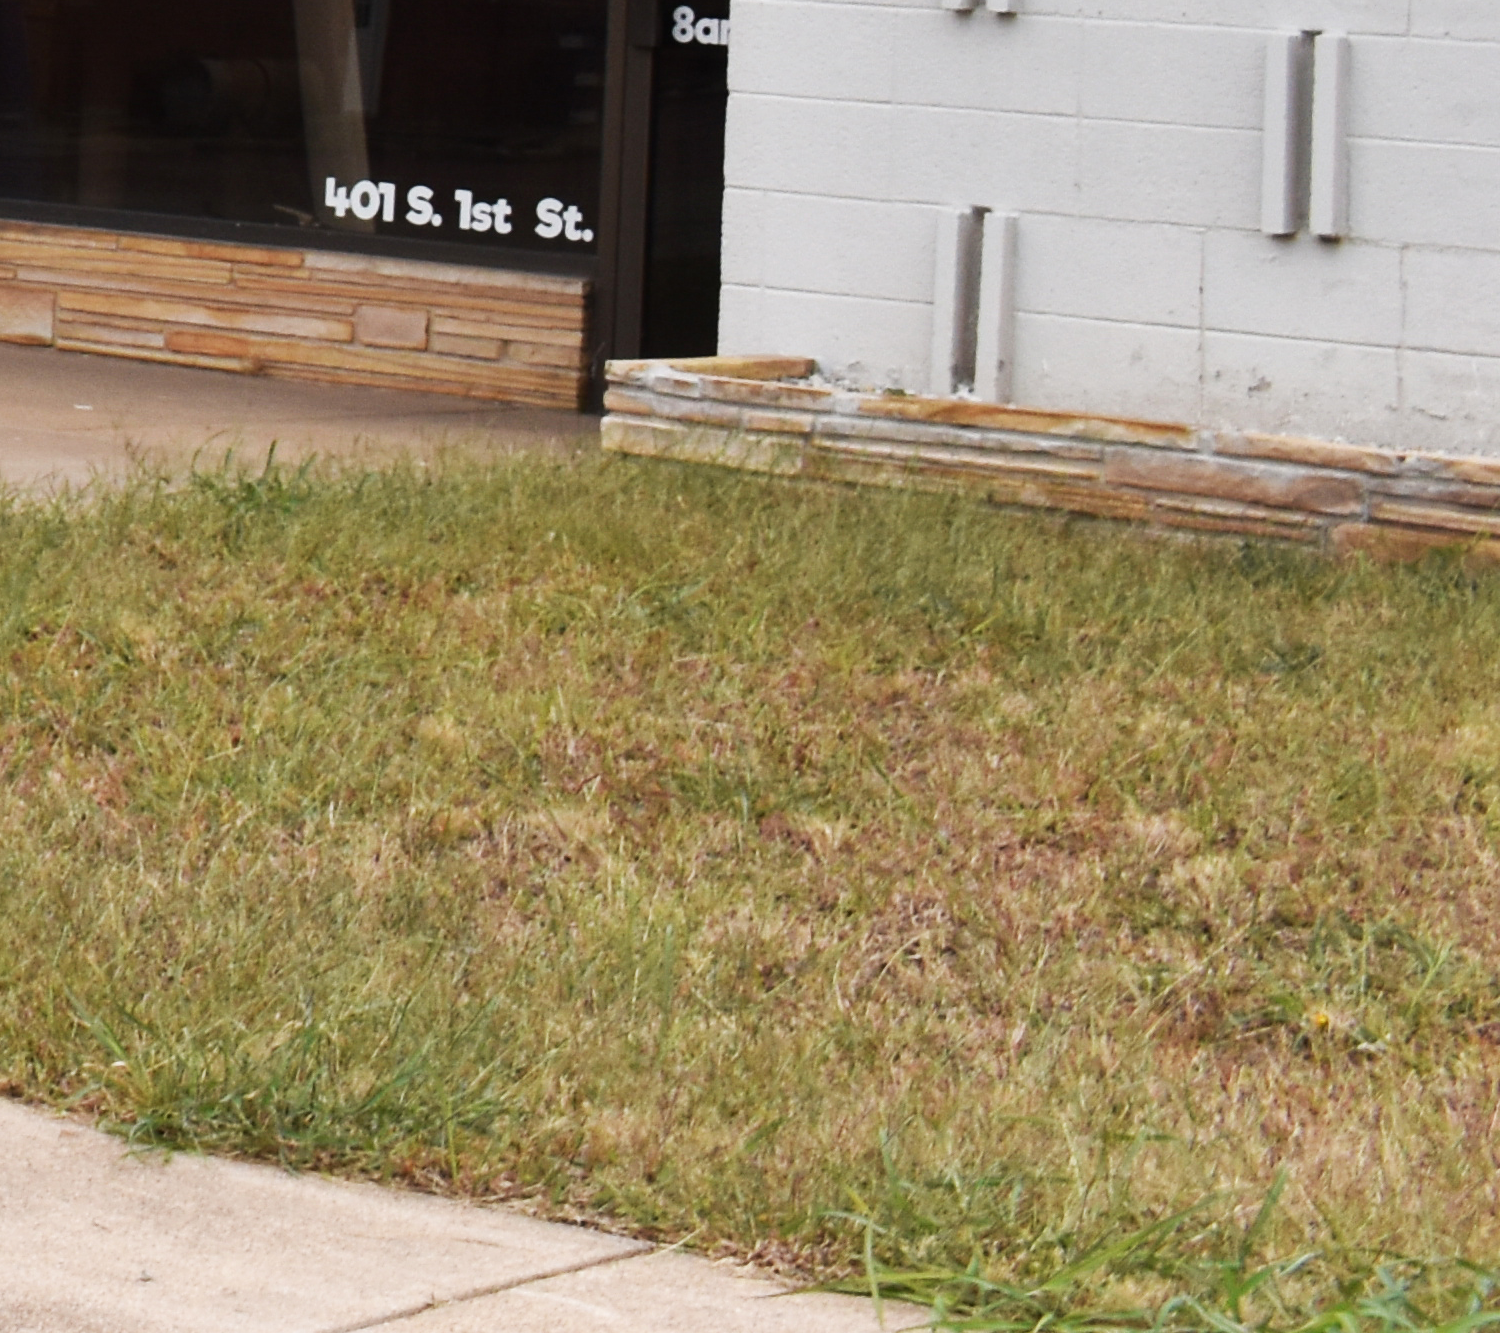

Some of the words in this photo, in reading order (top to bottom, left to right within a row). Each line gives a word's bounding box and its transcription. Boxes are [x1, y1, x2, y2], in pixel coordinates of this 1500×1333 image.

[323, 176, 396, 223] 401
[405, 185, 443, 227] S.
[455, 189, 512, 235] 1st
[534, 197, 594, 243] St.
